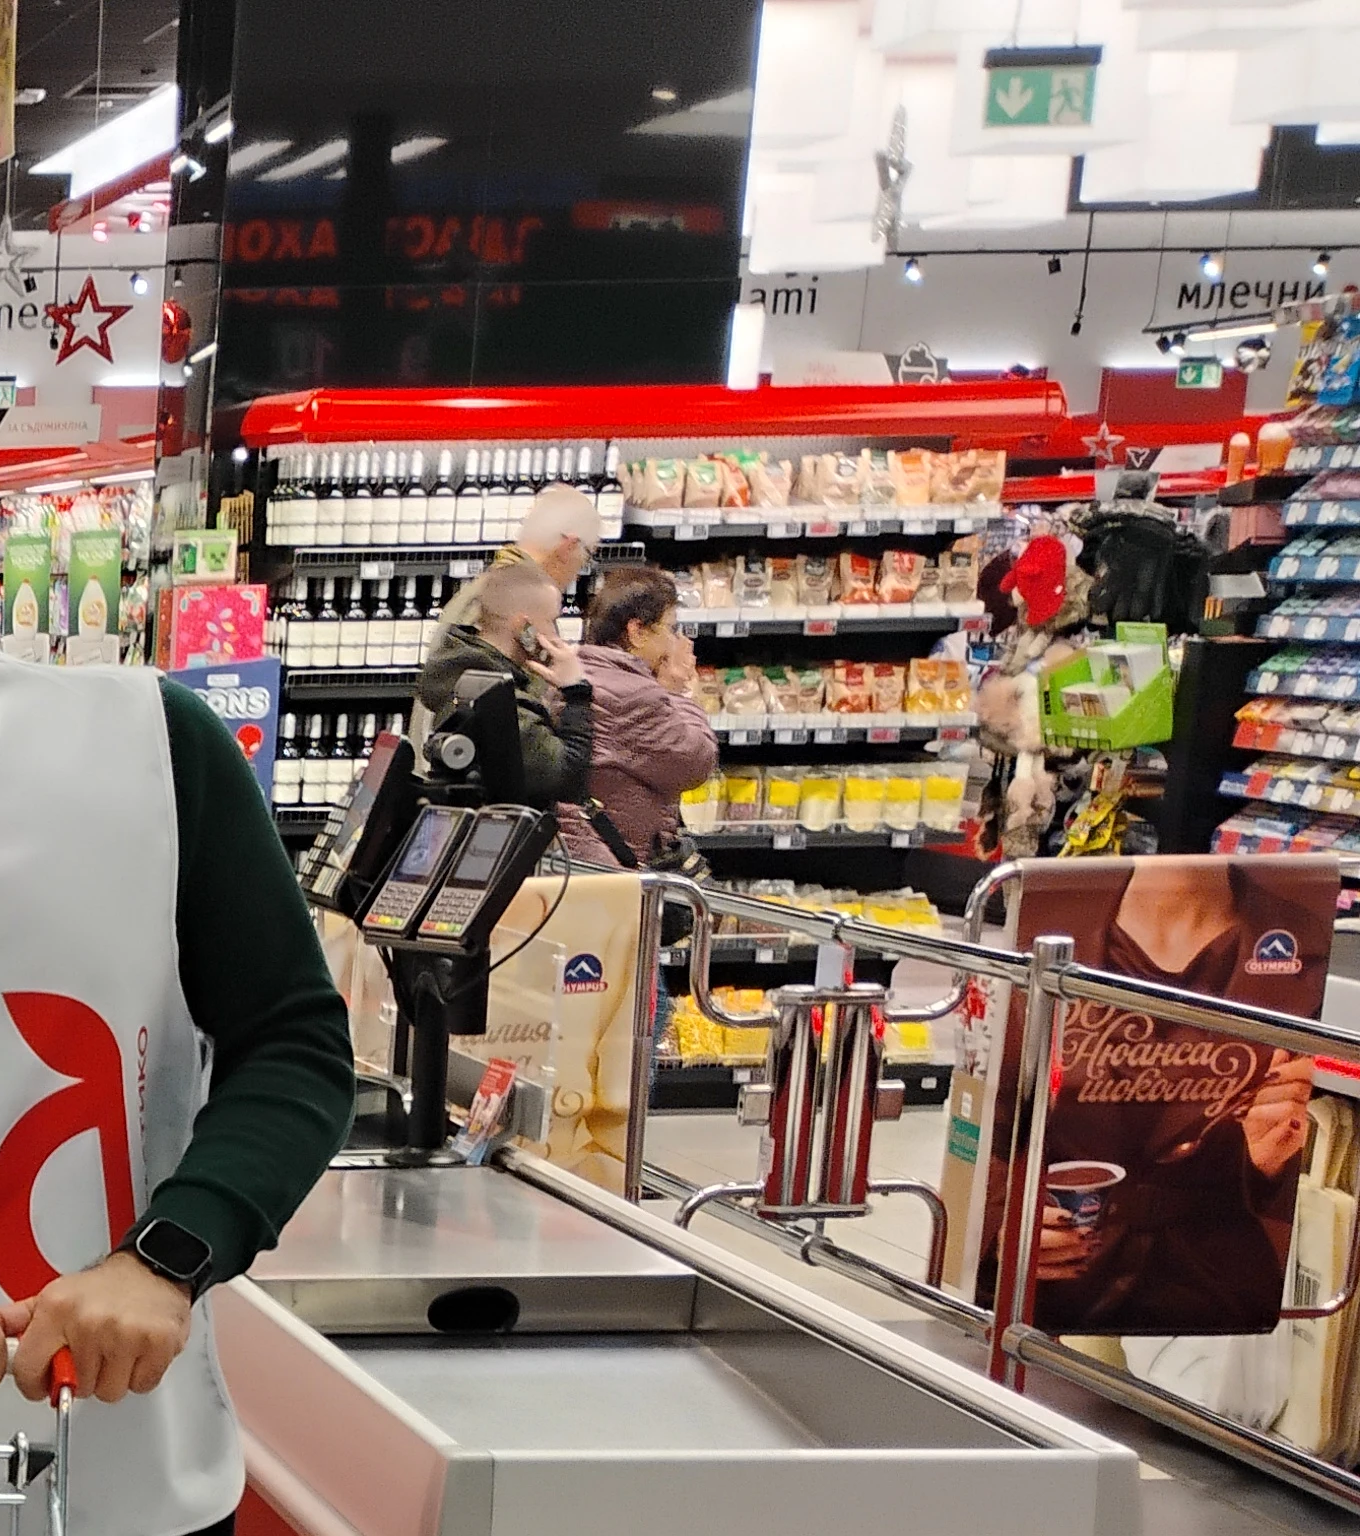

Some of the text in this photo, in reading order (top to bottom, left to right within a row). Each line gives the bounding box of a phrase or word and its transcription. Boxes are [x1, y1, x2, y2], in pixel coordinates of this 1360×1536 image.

[1176, 278, 1327, 310] млечни
[1248, 961, 1299, 973] OLYMPUS
[1077, 1050, 1252, 1117] шоколад
